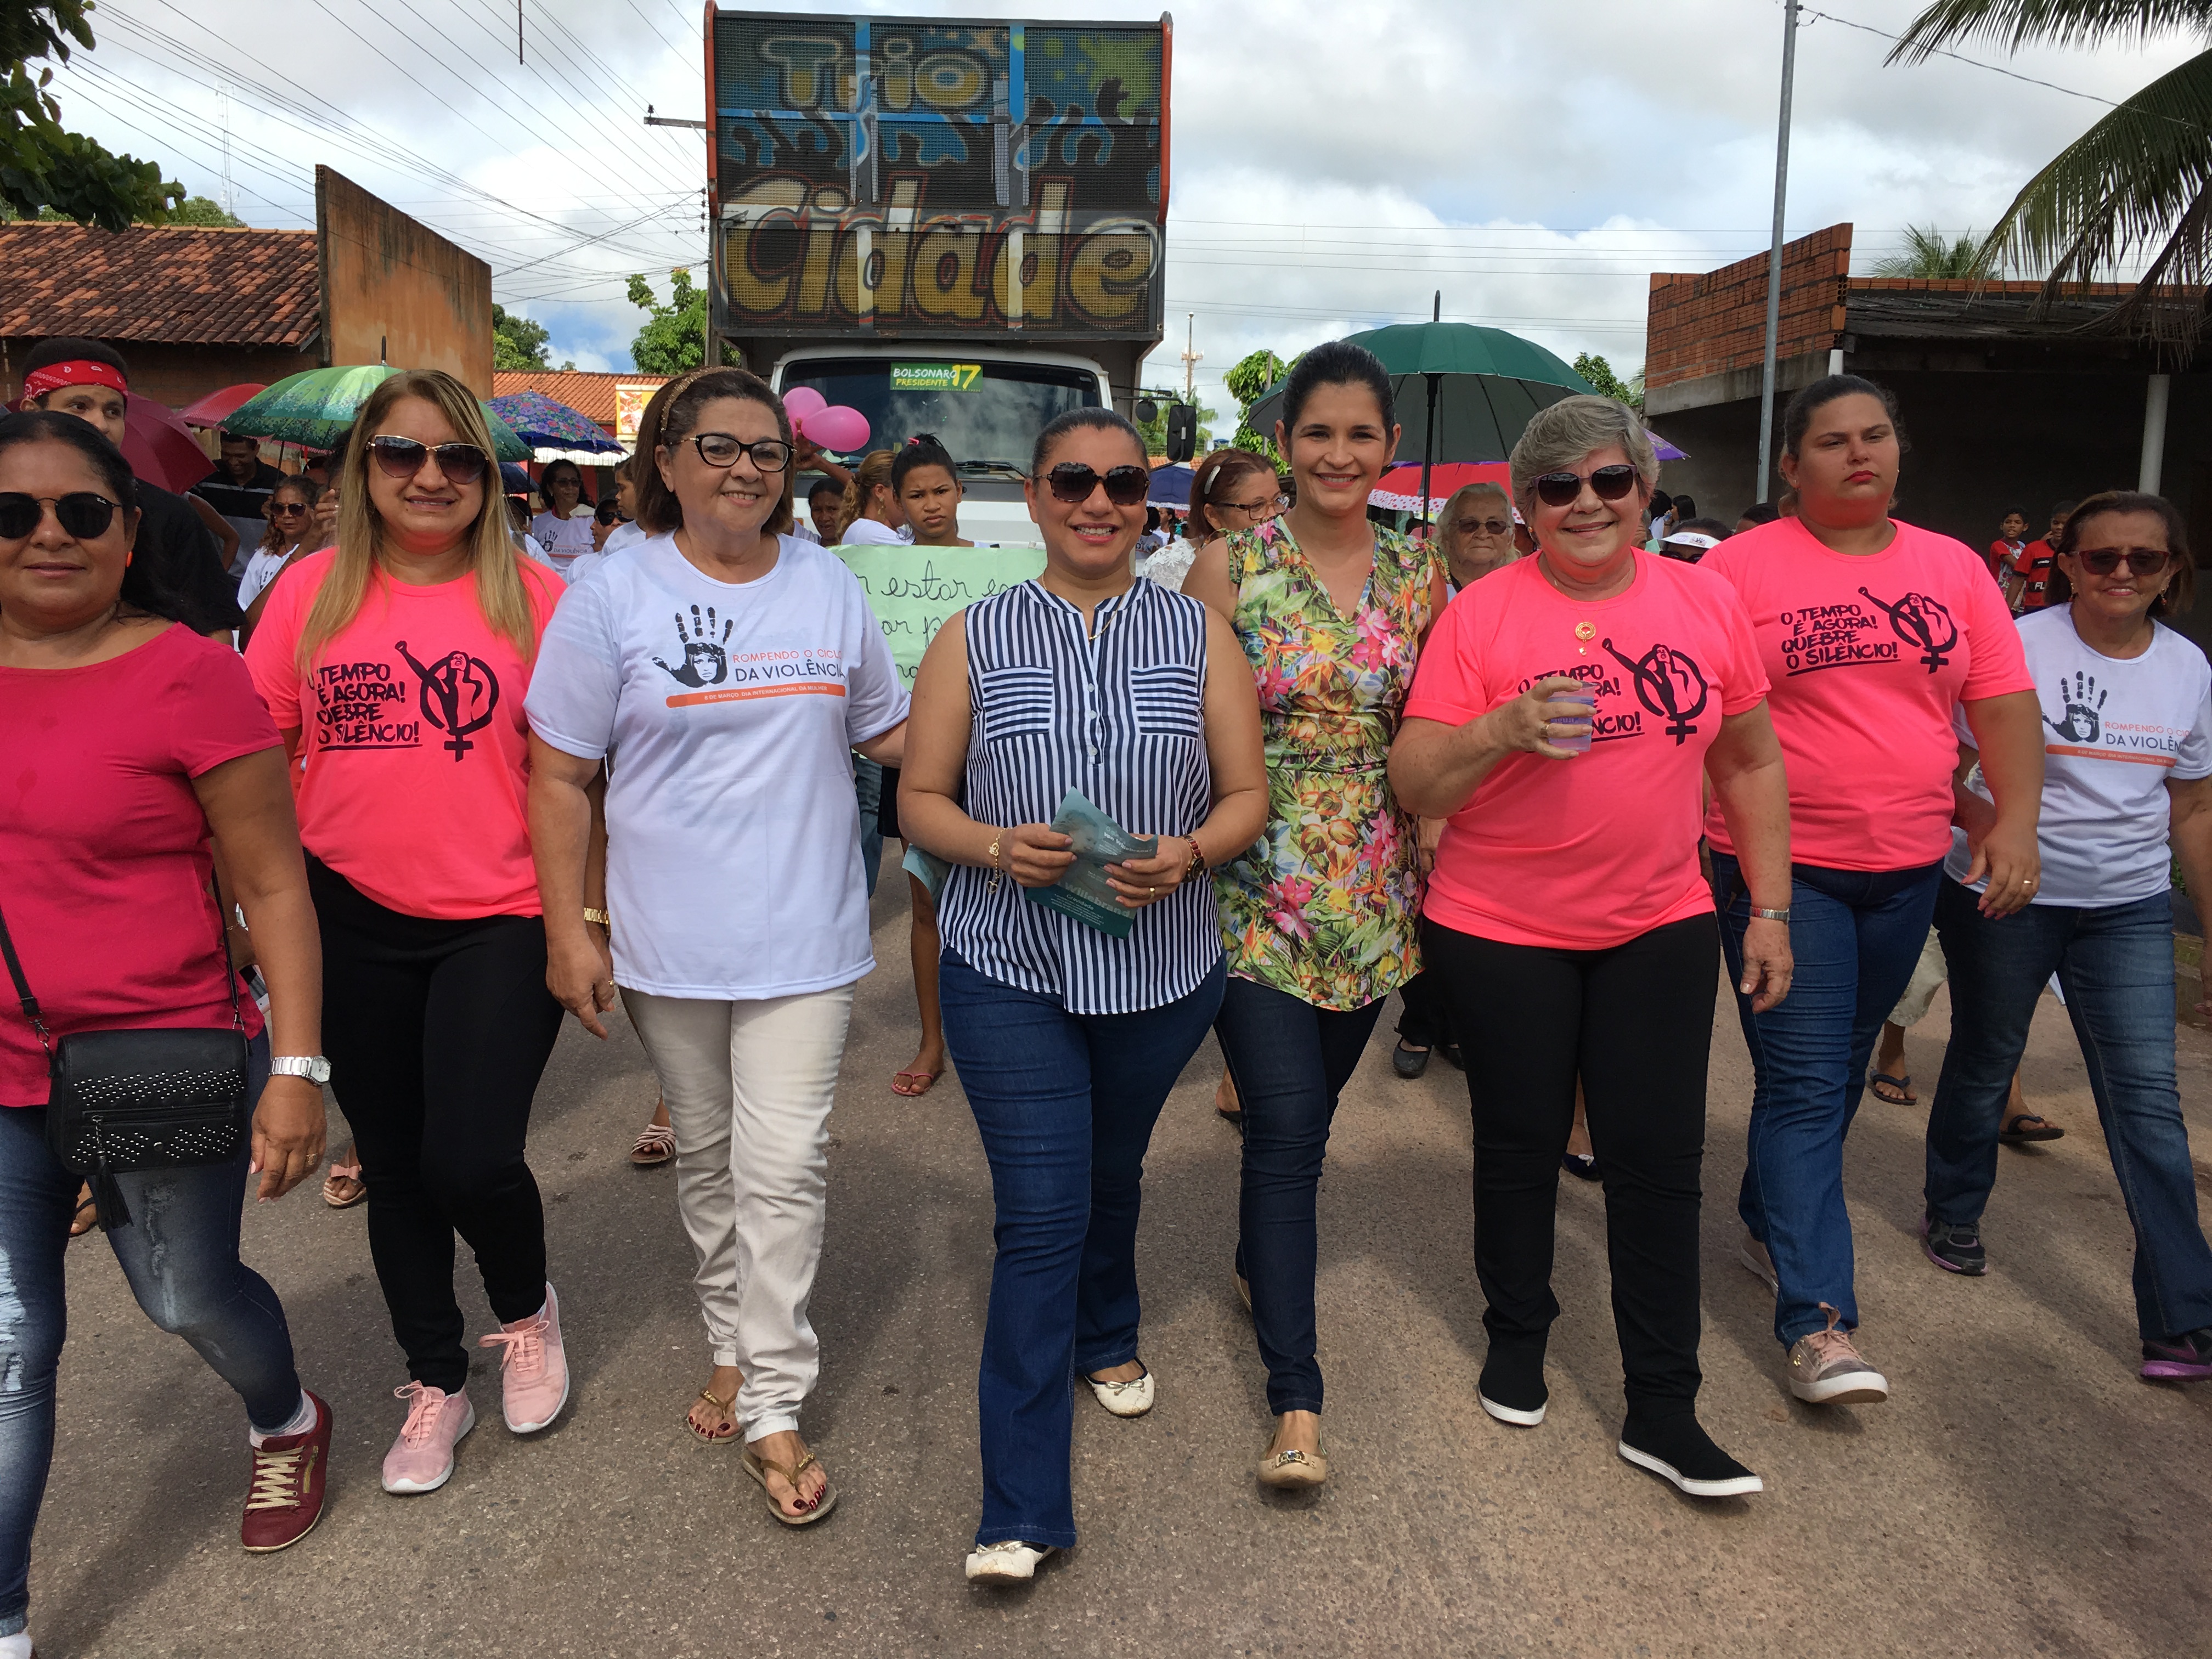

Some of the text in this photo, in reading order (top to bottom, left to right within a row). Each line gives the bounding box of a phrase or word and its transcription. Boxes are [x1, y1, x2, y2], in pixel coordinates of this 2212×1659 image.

[719, 171, 1159, 330] Cidade
[893, 364, 981, 390] BOLSONARO 17
[896, 378, 949, 387] PRESIDENTE
[881, 560, 973, 601] estar
[1781, 605, 1861, 625] O TEMPO
[1793, 615, 1878, 637] É AGORA!
[1781, 630, 1861, 653] QUEBRE
[733, 650, 799, 663] ROMPENDO
[1786, 641, 1898, 669] O SILÊNCIO!
[317, 662, 391, 686] TEMPO
[735, 659, 845, 682] DA VIOLÊNCIA
[318, 683, 331, 707] É
[334, 681, 405, 703] AGORA!
[752, 686, 798, 696] INTERNACIONAL
[2105, 721, 2164, 733] ROMPENDO
[2106, 733, 2182, 753] DA VIOLÊN
